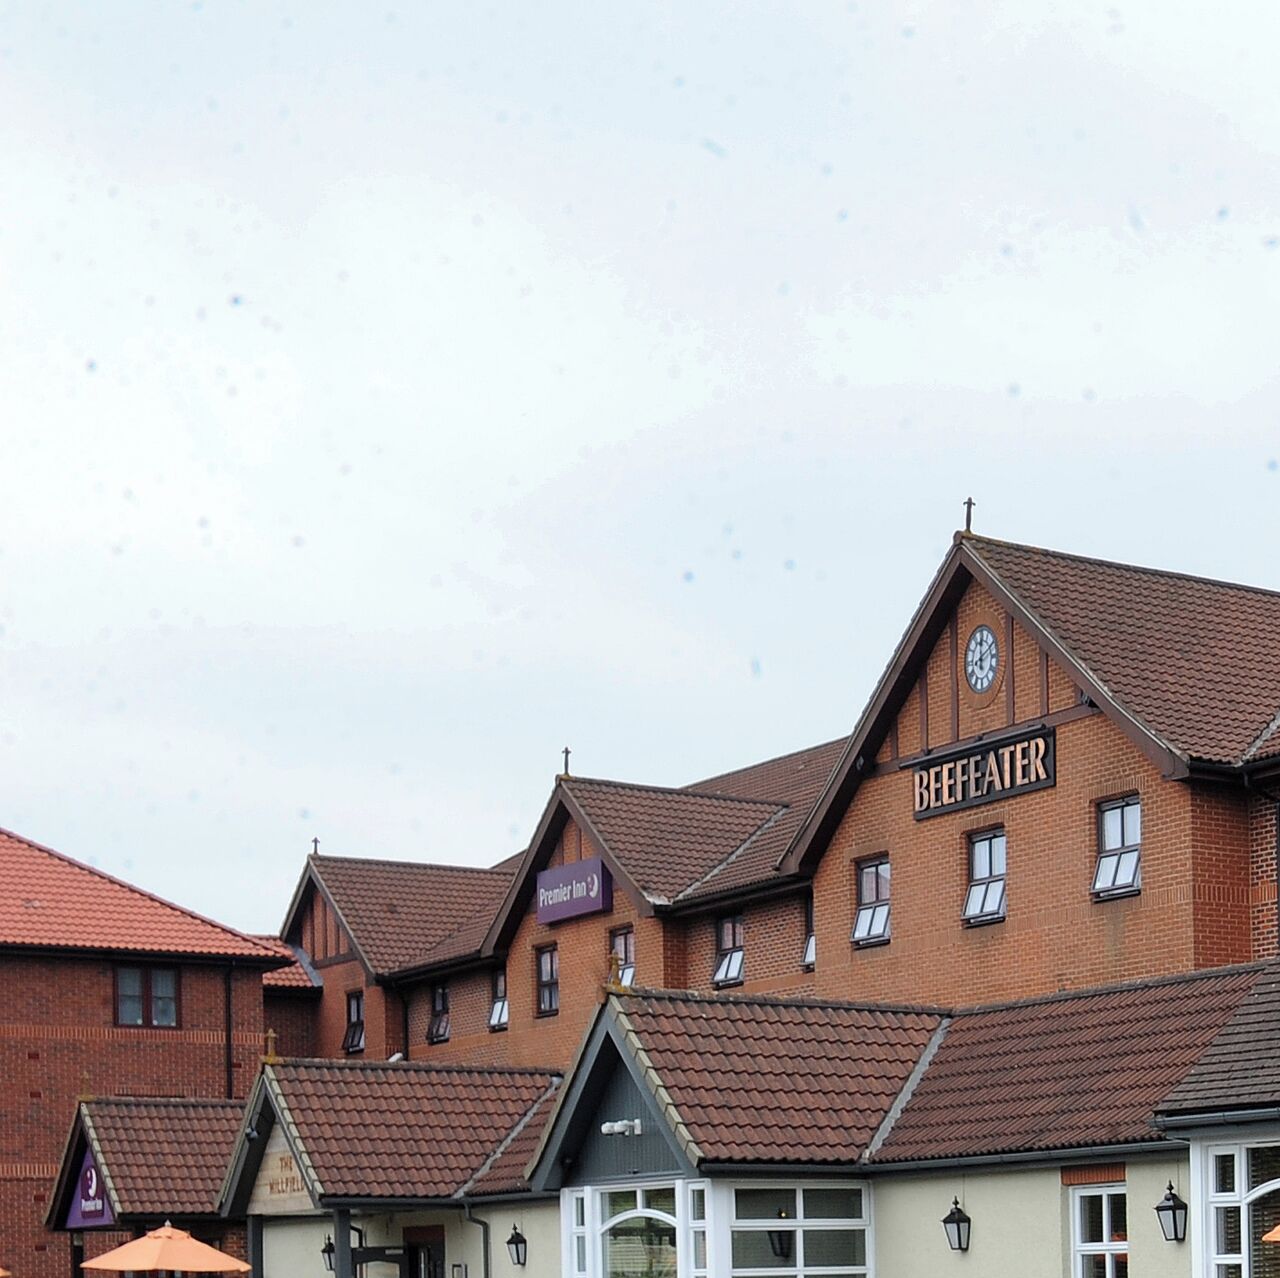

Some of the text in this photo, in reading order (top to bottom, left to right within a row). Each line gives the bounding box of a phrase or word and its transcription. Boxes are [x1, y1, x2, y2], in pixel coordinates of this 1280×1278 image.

[914, 737, 1047, 812] BEEFEATER
[540, 880, 587, 908] Premier Inn
[279, 1155, 293, 1172] THE
